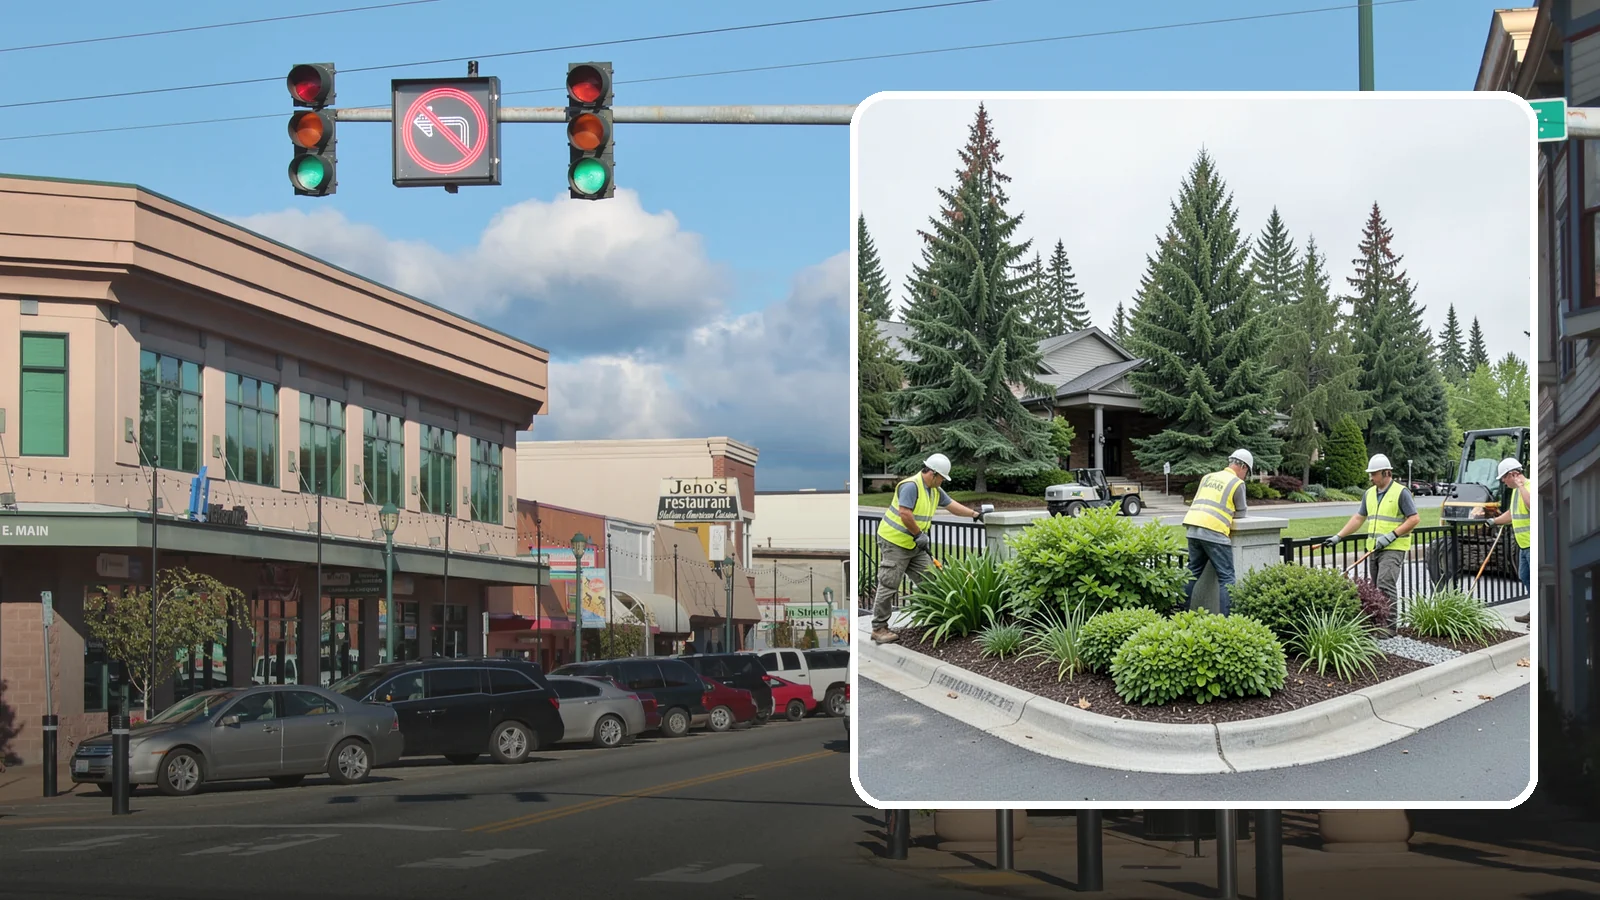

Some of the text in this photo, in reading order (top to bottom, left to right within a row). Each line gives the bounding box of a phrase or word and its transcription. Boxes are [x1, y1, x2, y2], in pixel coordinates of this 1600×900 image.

[669, 480, 727, 495] Jeno's
[665, 496, 731, 509] restaurant
[658, 510, 681, 519] Italian
[686, 510, 715, 519] American
[715, 509, 738, 519] Cuisine
[2, 525, 49, 536] E. MAIN
[797, 607, 828, 617] Street
